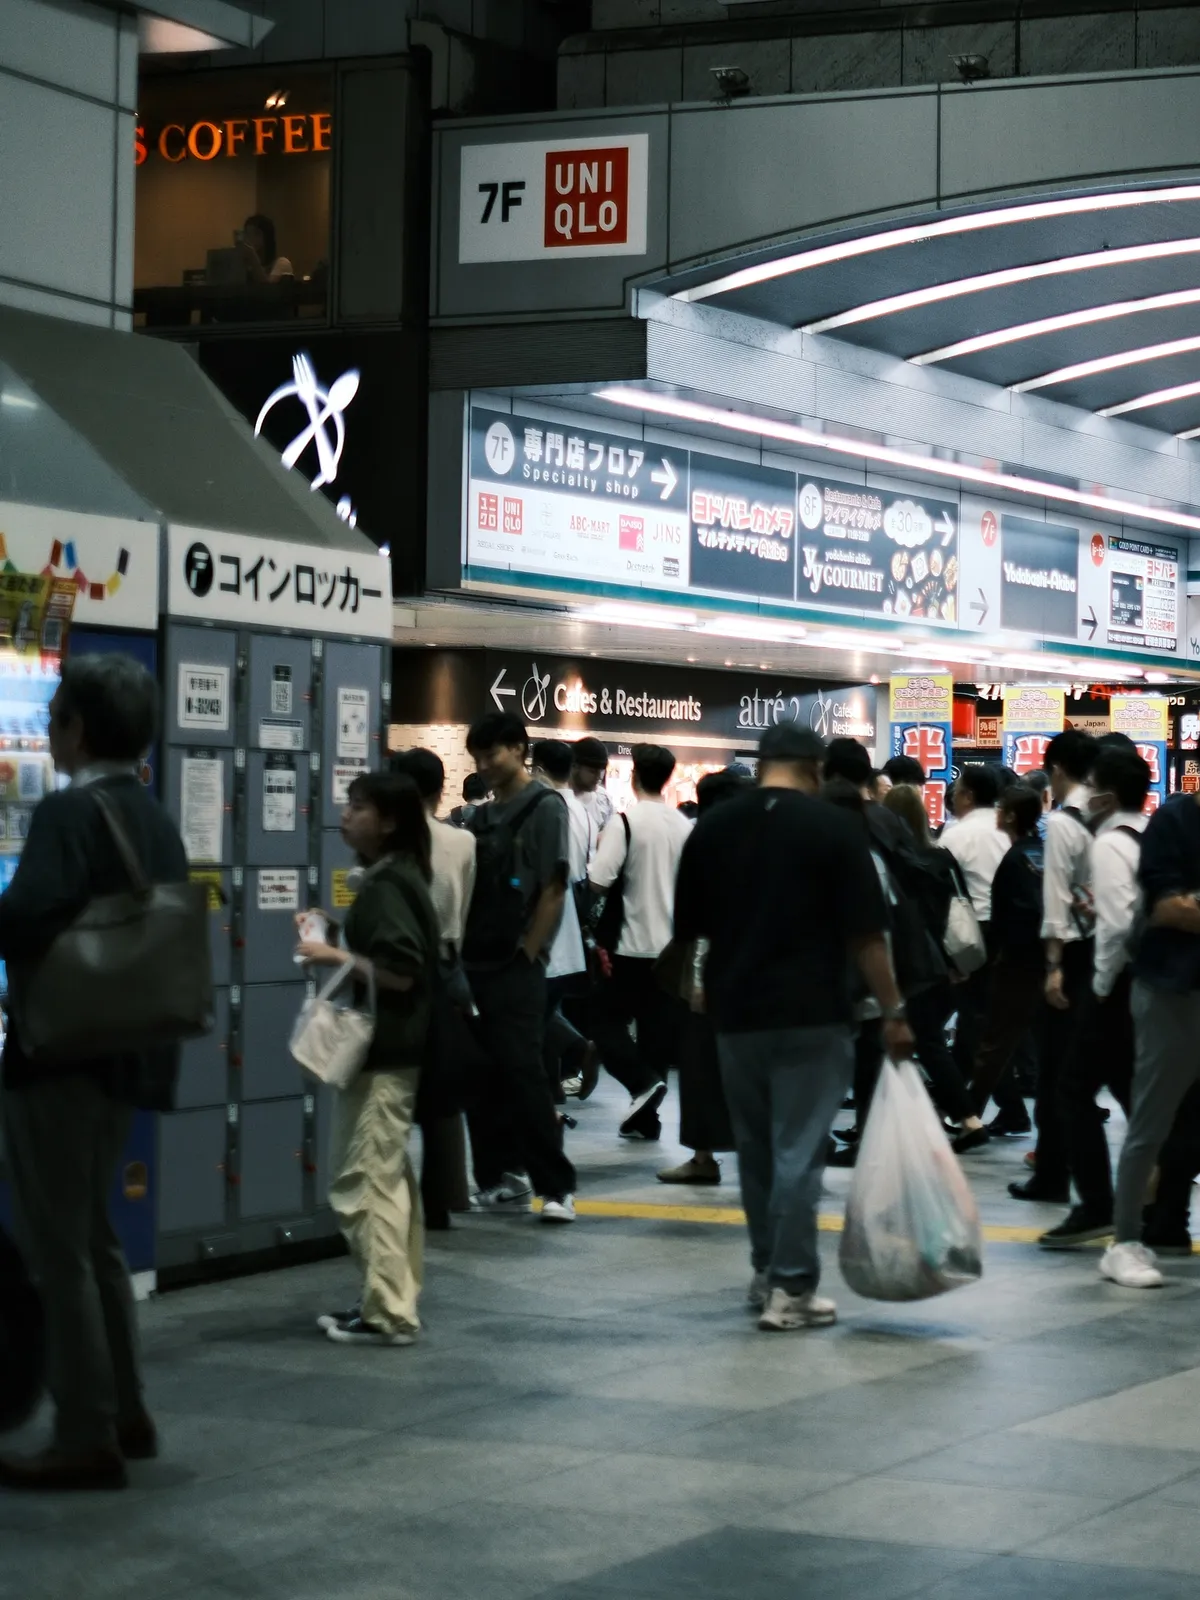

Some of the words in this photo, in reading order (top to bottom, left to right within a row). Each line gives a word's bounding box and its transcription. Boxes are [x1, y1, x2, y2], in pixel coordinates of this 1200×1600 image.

[159, 113, 331, 162] COFFEE
[555, 160, 614, 195] UNI
[478, 181, 526, 224] 7F
[553, 199, 618, 240] QLO
[490, 435, 510, 461] 7F
[522, 427, 645, 479] 専門店フロア
[523, 463, 597, 492] Specialty
[605, 475, 639, 498] shop
[504, 499, 520, 516] UNI
[504, 515, 522, 531] QLO
[692, 491, 793, 538] ヨドバシカメラ
[803, 495, 818, 516] 8F
[983, 517, 996, 539] 7F
[219, 553, 383, 614] コインロッカー
[823, 564, 884, 593] GOURMET
[1004, 562, 1077, 593] Yodobashi-Akiba
[553, 683, 597, 714] Cafes
[599, 687, 614, 712] &
[615, 687, 701, 722] Restaurants
[738, 687, 786, 727] atré
